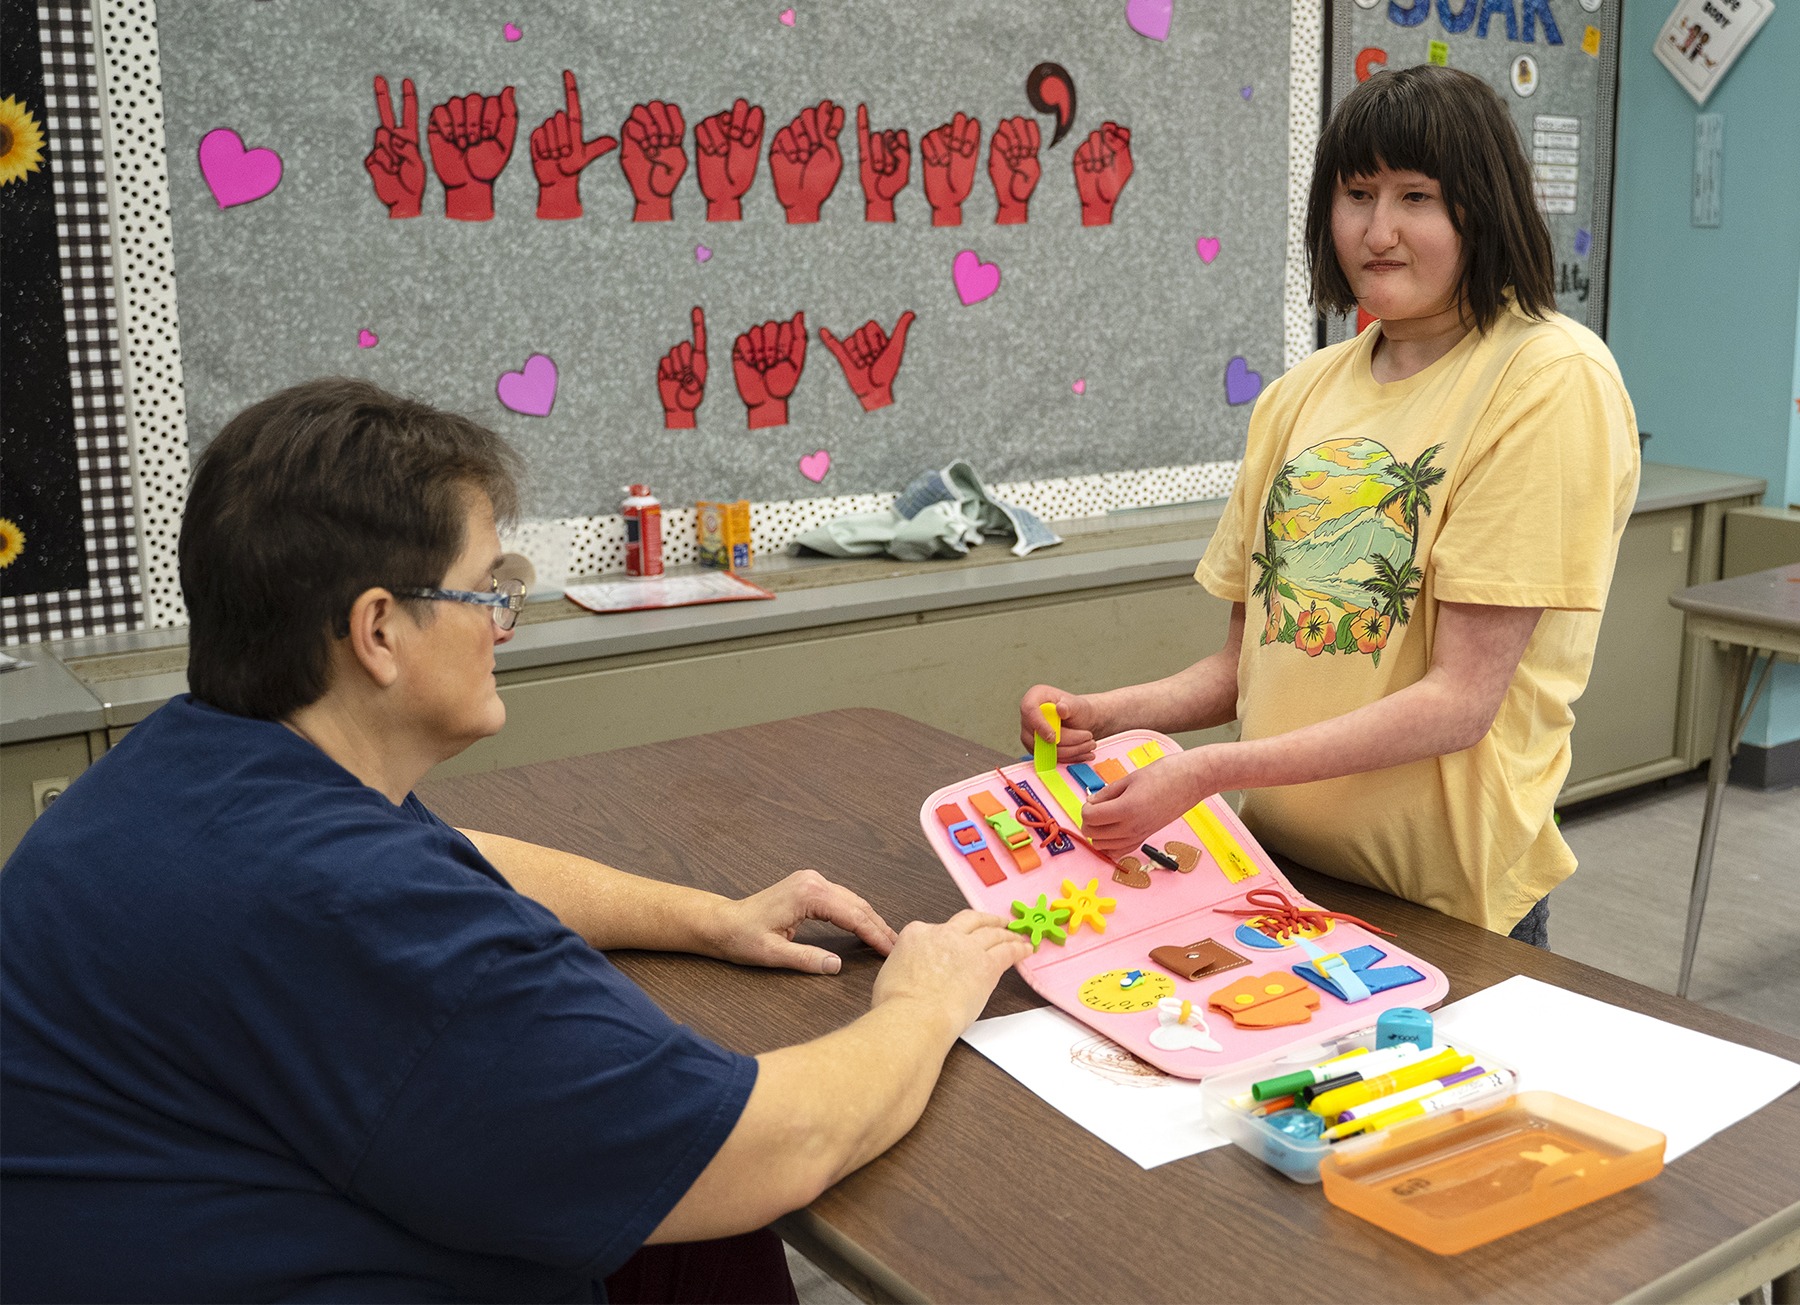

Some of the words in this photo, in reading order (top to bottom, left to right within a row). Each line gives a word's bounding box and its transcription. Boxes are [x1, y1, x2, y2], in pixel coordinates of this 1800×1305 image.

[1085, 996, 1101, 1005] 12
[1119, 1000, 1135, 1010] 10
[1101, 1001, 1116, 1010] 11
